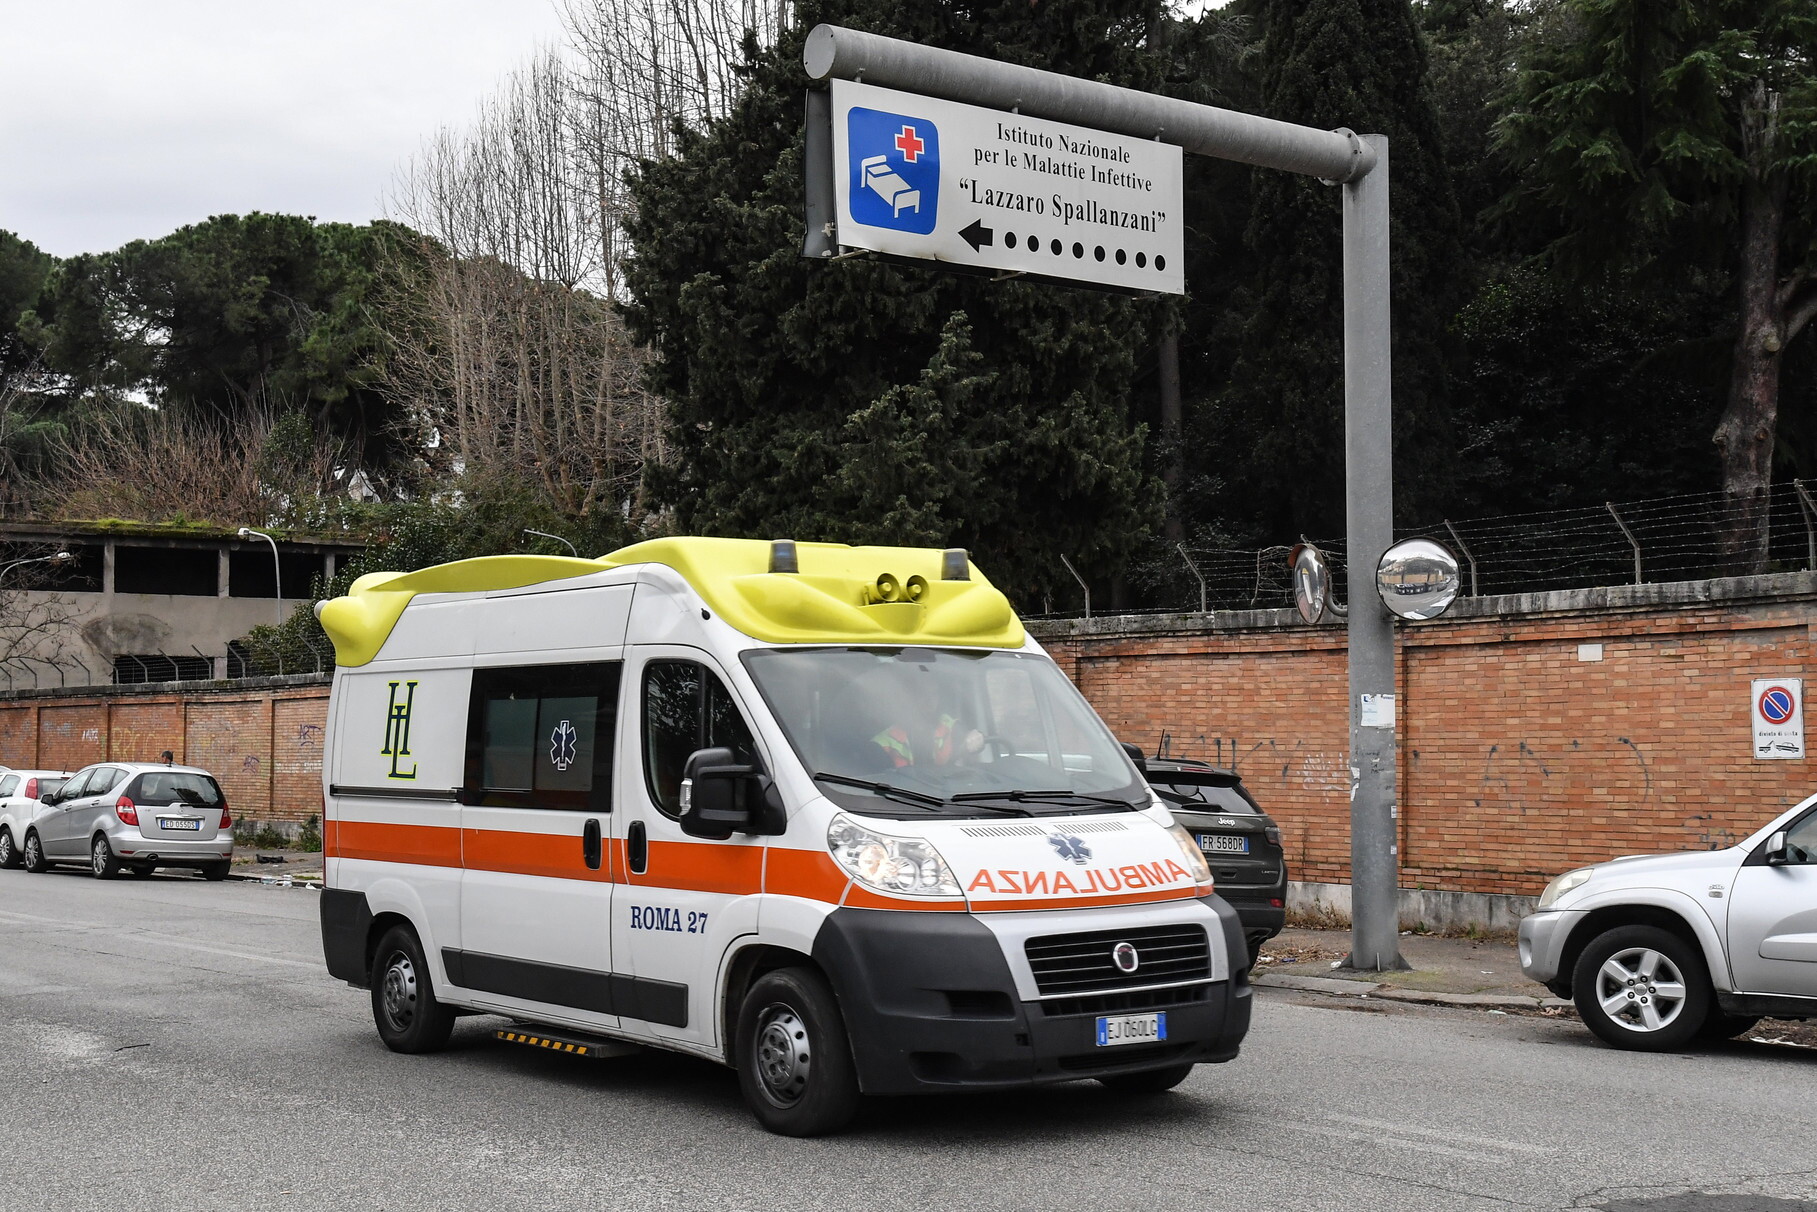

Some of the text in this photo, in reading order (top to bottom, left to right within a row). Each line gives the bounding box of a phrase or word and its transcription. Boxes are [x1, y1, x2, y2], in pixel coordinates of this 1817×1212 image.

[997, 122, 1131, 163] Istituto Nazionale
[974, 147, 1152, 192] per le Malattie Infettive
[959, 177, 1166, 233] “Lazzaro Spallanzani”
[1218, 817, 1236, 827] Jeep
[1202, 836, 1244, 850] FR 568DR
[630, 905, 709, 934] ROMA 27
